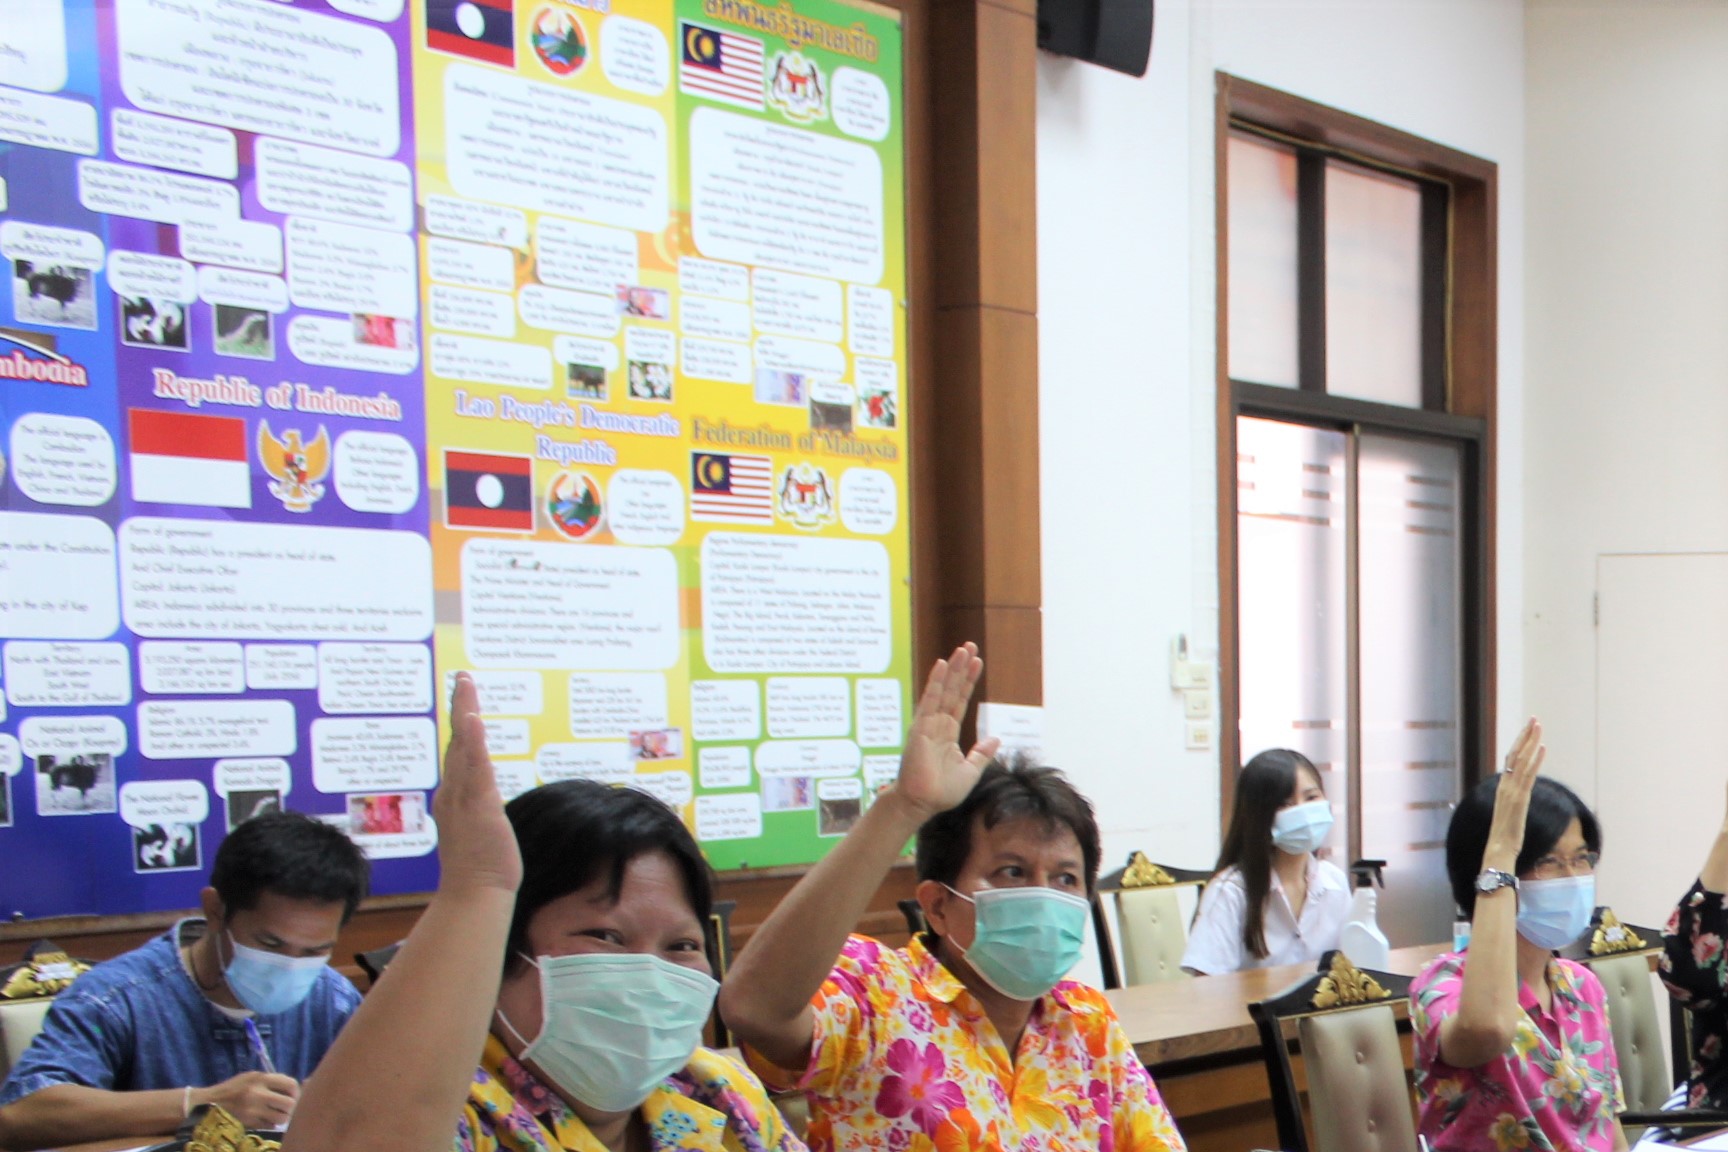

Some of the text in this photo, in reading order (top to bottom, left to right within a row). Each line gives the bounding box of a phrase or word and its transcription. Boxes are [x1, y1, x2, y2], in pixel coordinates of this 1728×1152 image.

[705, 0, 877, 62] สหพนธรัฐมาเลเซีย
[152, 368, 402, 421] Republic of Indonesia
[455, 390, 680, 436] Lao People's Democratic
[536, 434, 616, 466] Republic
[691, 418, 898, 463] Federation of Malaysia
